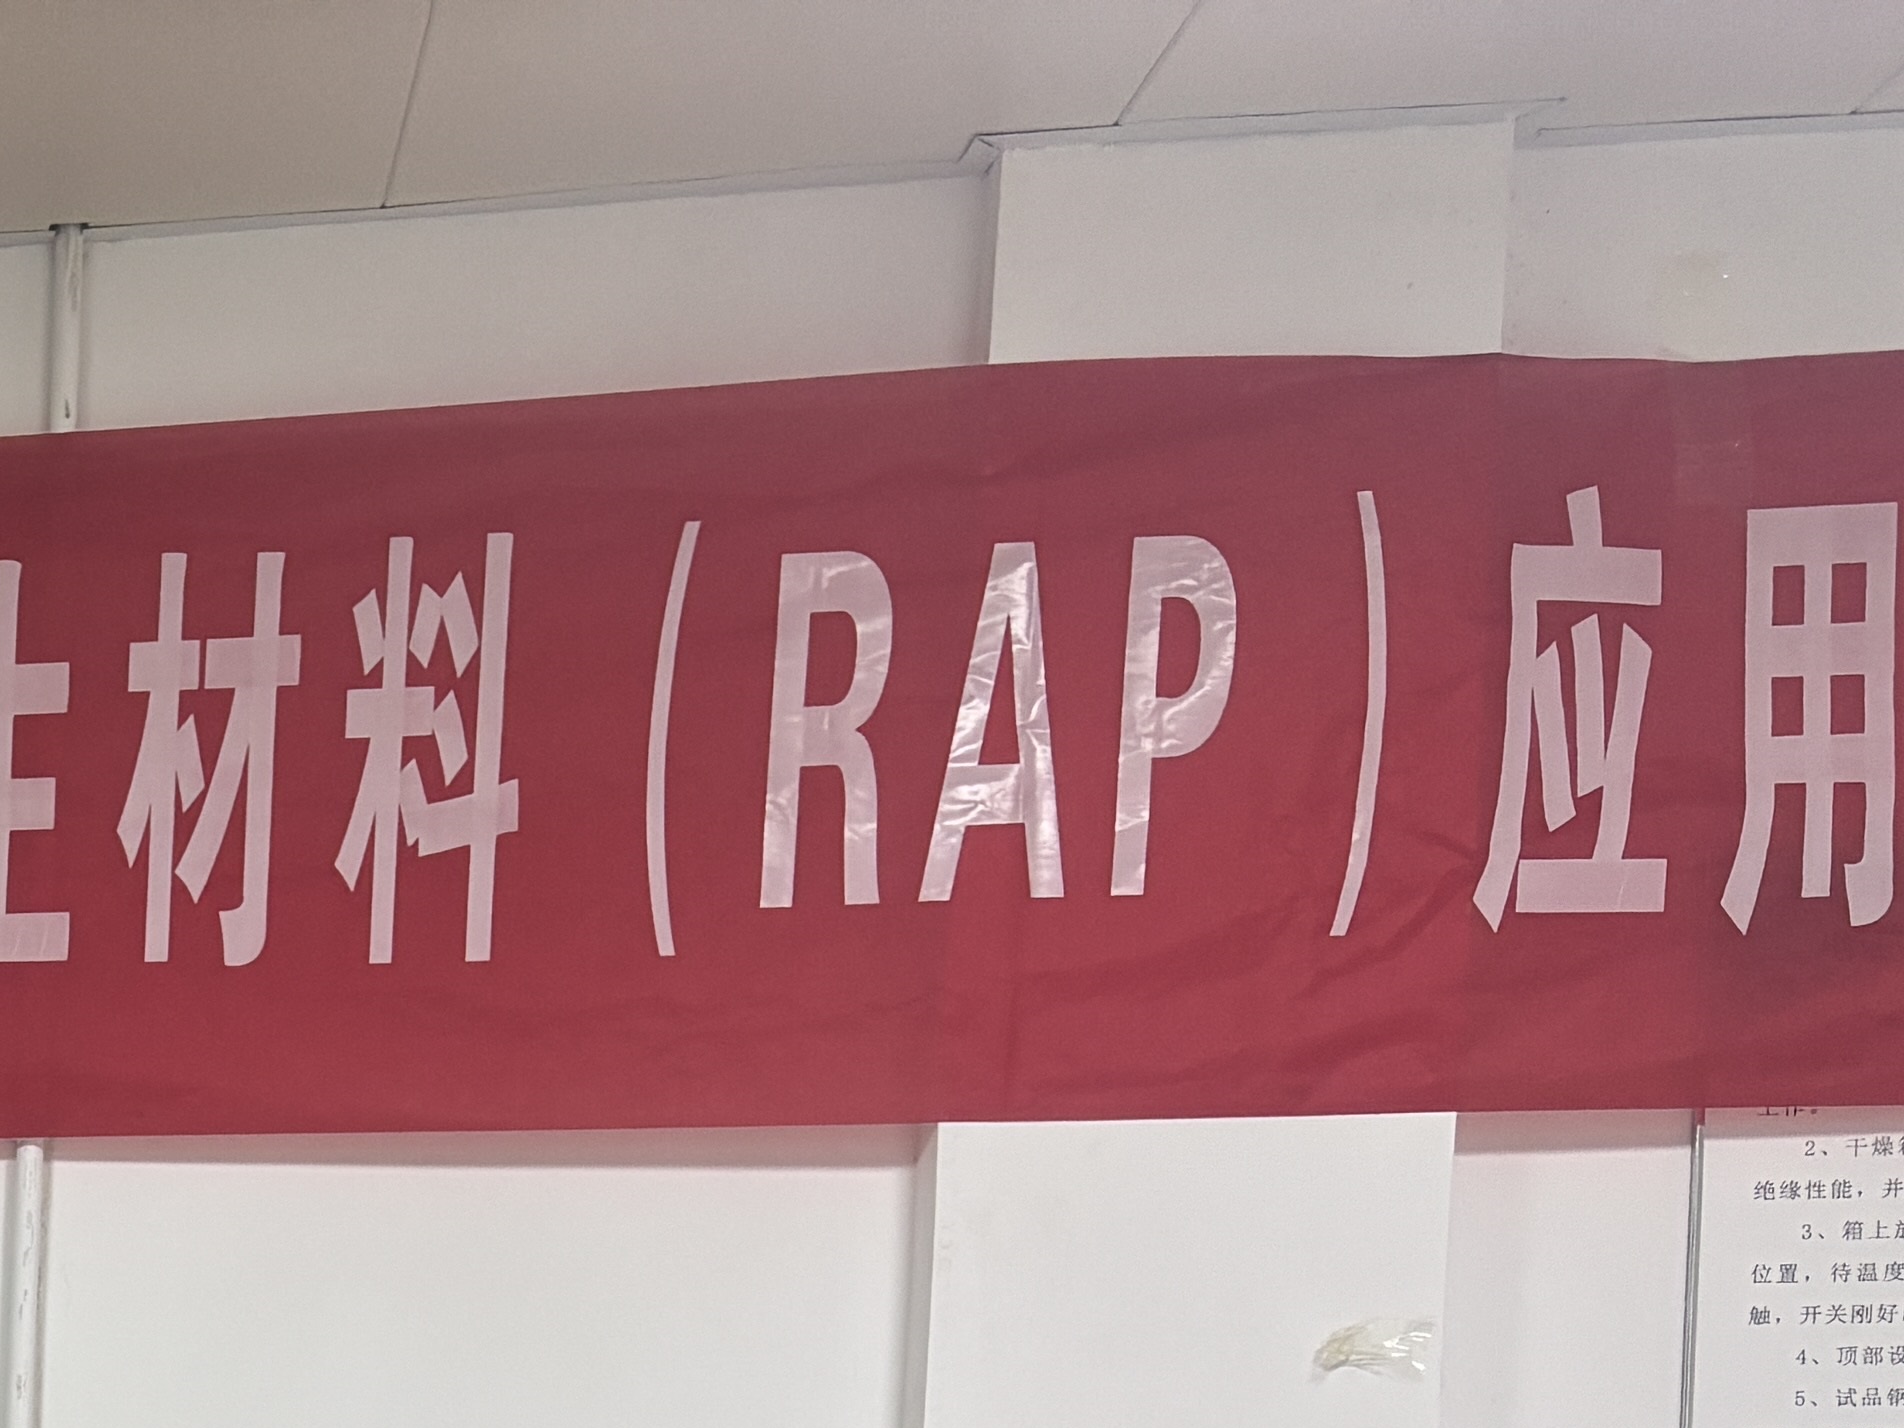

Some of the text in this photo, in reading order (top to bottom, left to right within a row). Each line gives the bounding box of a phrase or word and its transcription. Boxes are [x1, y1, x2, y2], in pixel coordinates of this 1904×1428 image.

[1753, 1178, 1904, 1201] 绝缘性能，并
[1751, 1261, 1904, 1284] 位置，待温度
